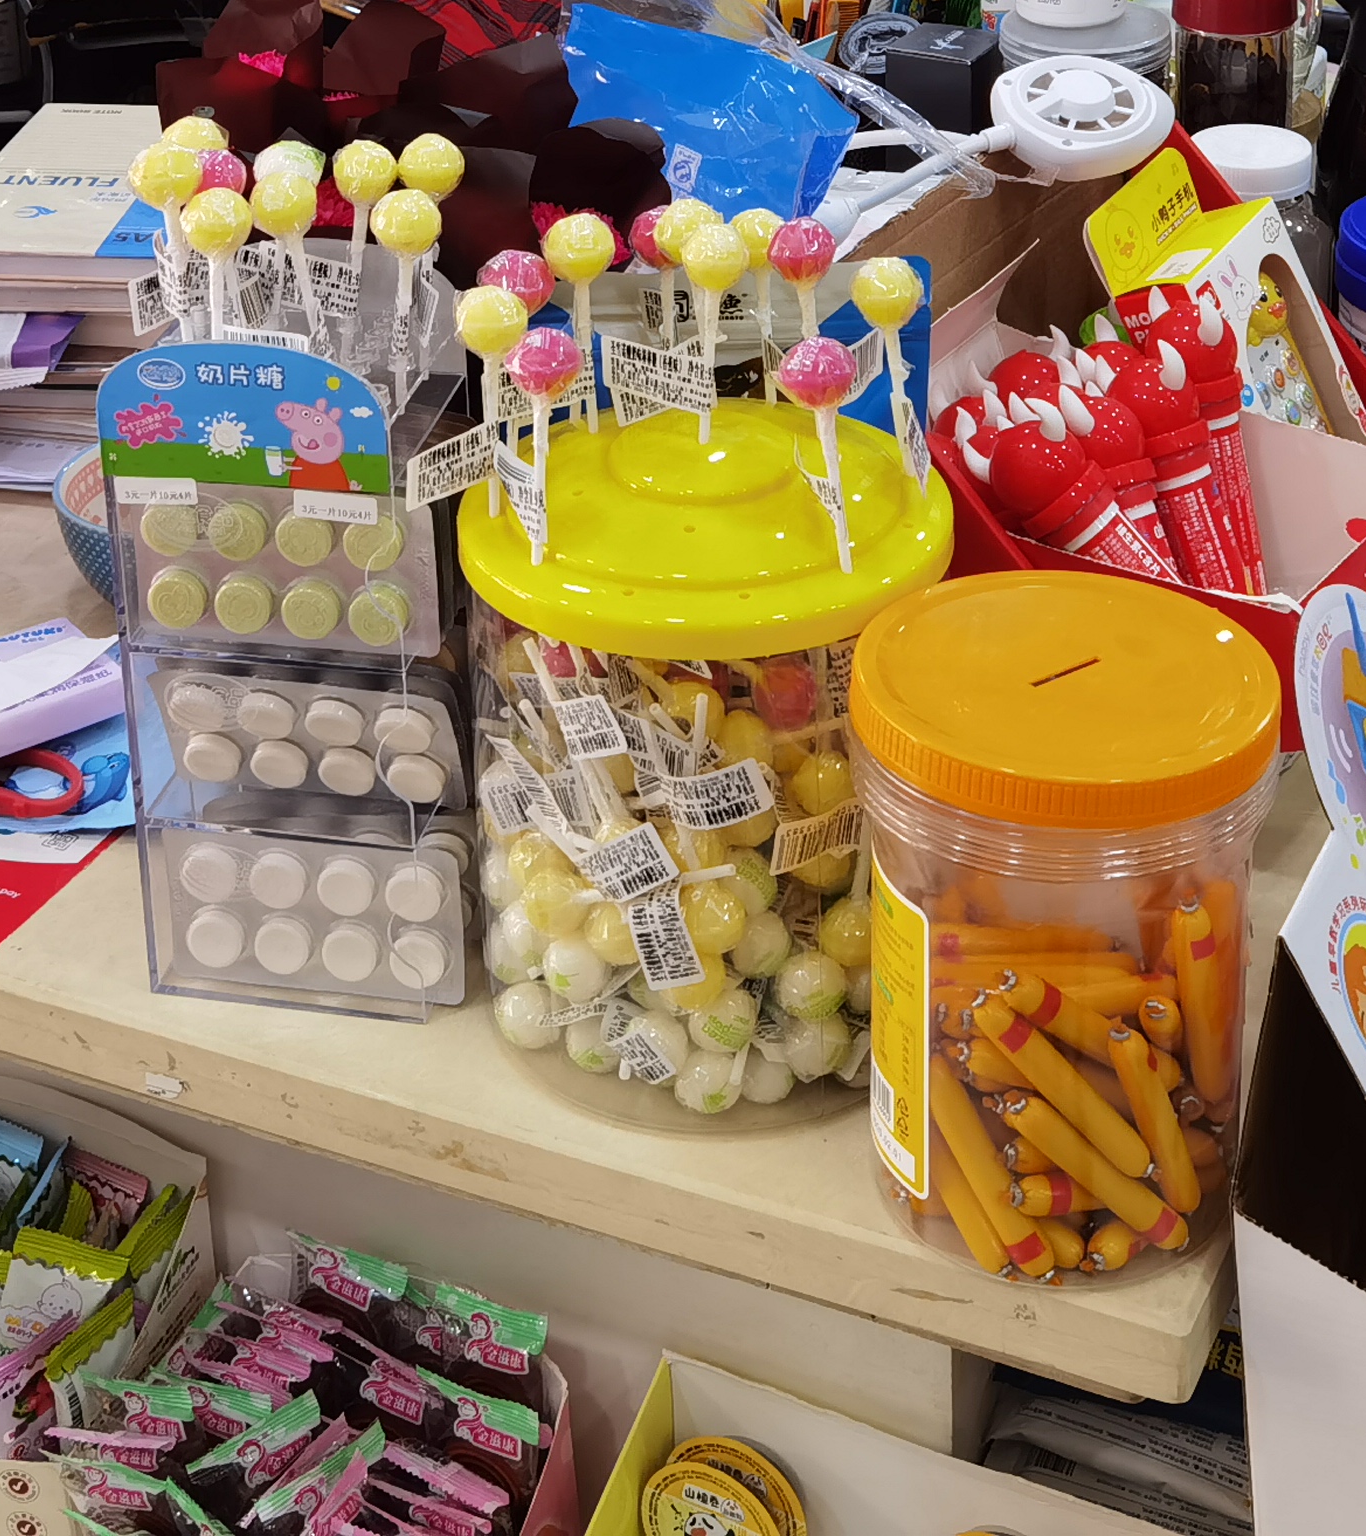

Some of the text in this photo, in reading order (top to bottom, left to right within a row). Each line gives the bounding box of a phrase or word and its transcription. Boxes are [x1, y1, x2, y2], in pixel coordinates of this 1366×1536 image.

[1151, 181, 1196, 233] 小鸭子手机
[112, 230, 154, 245] A5
[195, 363, 286, 391] 奶片糖
[124, 489, 193, 502] 3元一片10元4片
[301, 504, 373, 520] 3元一片10元4片
[1114, 523, 1163, 579] 维生素C含片
[683, 1486, 721, 1510] 山楂卷
